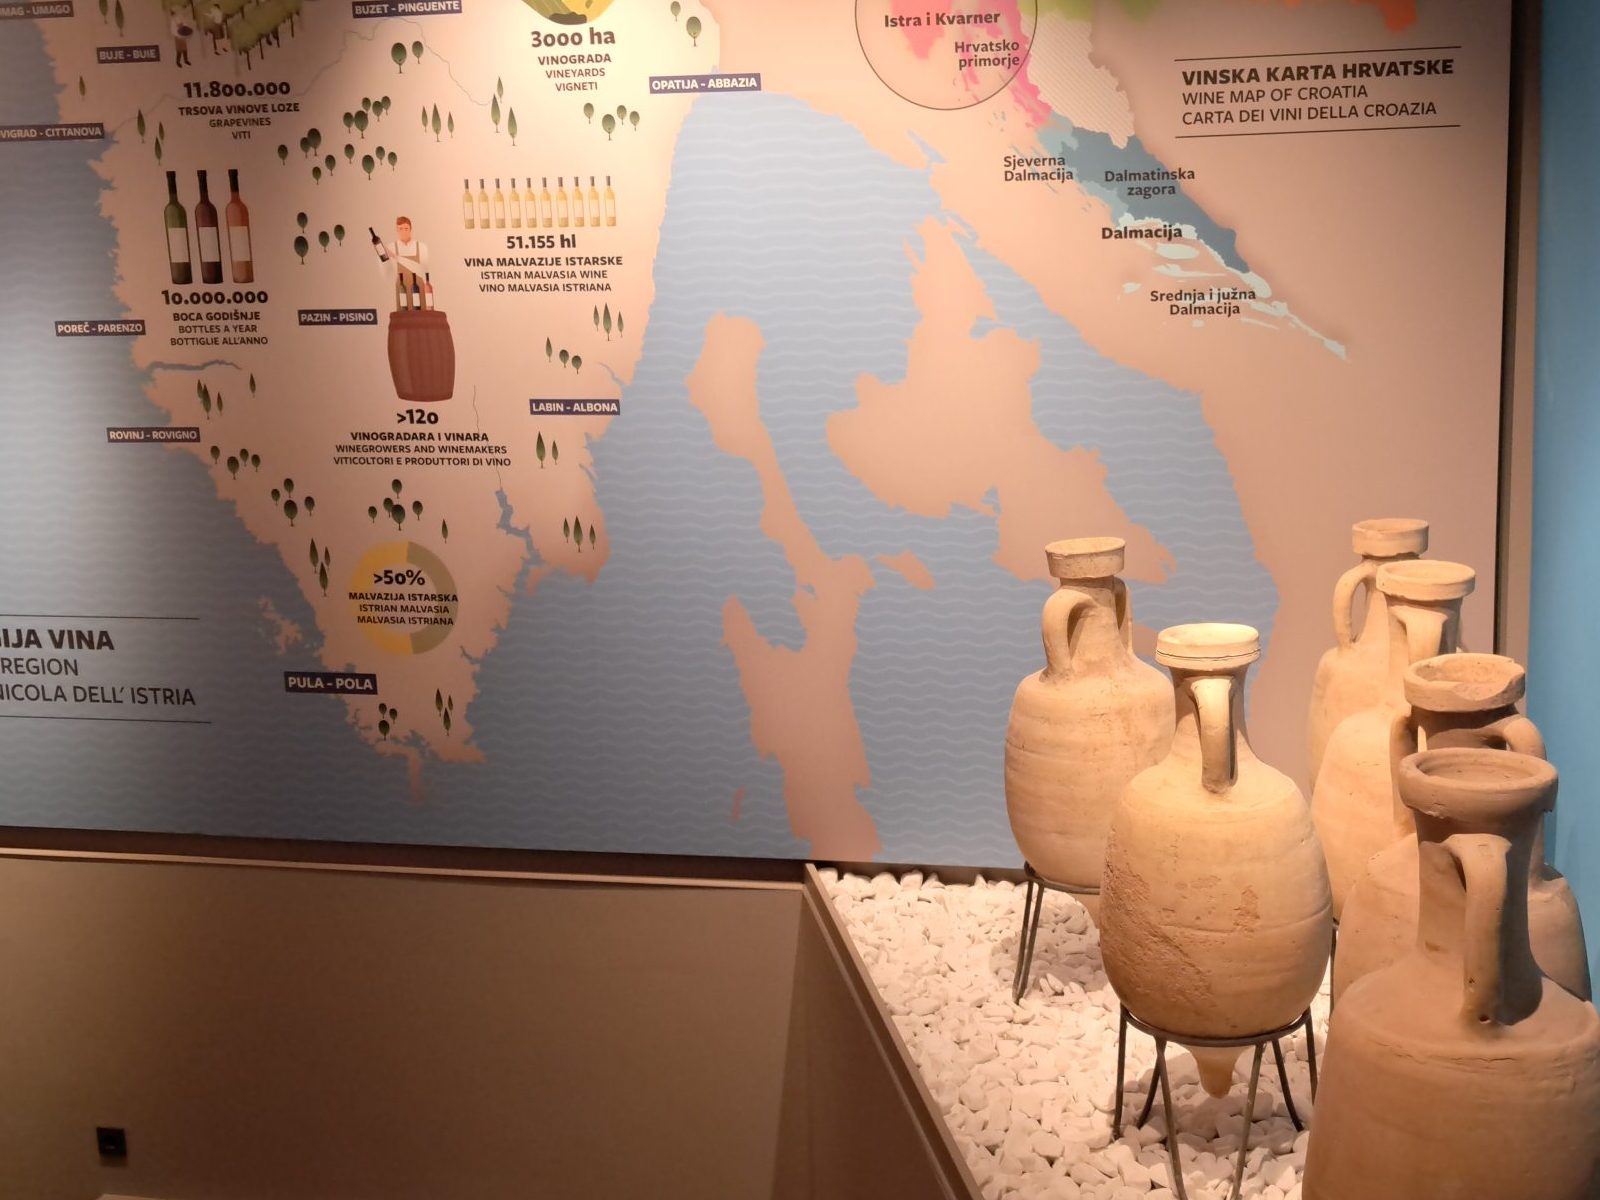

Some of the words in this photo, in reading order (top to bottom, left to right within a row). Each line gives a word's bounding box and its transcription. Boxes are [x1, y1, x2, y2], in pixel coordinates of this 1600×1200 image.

[355, 4, 388, 14] BUZET
[398, 1, 460, 12] PINGUENTE
[884, 14, 922, 27] Istra
[935, 12, 1000, 25] Kvarner
[531, 31, 583, 48] 3000
[589, 27, 616, 45] ha
[954, 39, 1020, 53] Hrvatsko
[538, 53, 612, 65] VINOGRADA
[959, 54, 1020, 70] primorje
[545, 68, 606, 79] VINEYARDS
[1182, 67, 1260, 86] VINSKA
[1266, 64, 1336, 82] KARTA
[1342, 59, 1455, 79] HRVATSKE
[183, 81, 291, 98] 11.800.000
[555, 82, 598, 91] VIGNETI
[652, 79, 699, 90] OPATIJA
[707, 77, 757, 88] ABBAZIA
[1182, 91, 1225, 105] WINE
[1230, 90, 1265, 103] MAP
[1270, 88, 1293, 102] OF
[1297, 85, 1368, 100] CROATIA
[178, 105, 223, 116] TRSOVA
[225, 104, 268, 114] VINOVE
[271, 102, 300, 112] LOZE
[1182, 111, 1234, 125] CARTA
[1239, 109, 1265, 122] DEI
[1270, 108, 1301, 121] VINI
[1307, 104, 1359, 120] DELLA
[1364, 101, 1437, 118] CROAZIA
[209, 117, 271, 127] GRAPEVINES
[45, 127, 102, 137] CITTANOVA
[232, 131, 251, 139] VITI
[1003, 155, 1066, 170] Sjeverna
[1004, 168, 1074, 183] Dalmacija
[1104, 168, 1195, 182] Dalmatinska
[1127, 185, 1176, 199] zagora
[1101, 225, 1183, 241] Dalmacija
[506, 235, 555, 249] 51.155
[560, 234, 576, 248] hl
[464, 258, 494, 267] VINA
[496, 257, 562, 267] MALVAZIJE
[566, 256, 623, 266] ISTARSKE
[481, 271, 522, 280] ISTRIAN
[525, 270, 577, 279] MALVASIA
[580, 270, 608, 279] WINE
[479, 284, 505, 292] VINO
[508, 283, 559, 292] MALVASIA
[563, 283, 612, 292] ISTRIANA
[161, 290, 268, 305] 10.000.000
[1150, 289, 1205, 304] Srednja
[1217, 288, 1256, 304] južna
[173, 312, 203, 321] BOCA
[206, 309, 261, 321] GODIŠNJE
[1170, 303, 1240, 317] Dalmacija
[301, 313, 331, 322] PAZIN
[339, 313, 374, 322] PISINO
[58, 321, 89, 333] POREČ
[98, 323, 142, 333] PARENZO
[178, 325, 221, 334] BOTTLES
[232, 325, 257, 333] YEAR
[170, 337, 219, 346] BOTTIGLIE
[532, 403, 564, 412] LABIN
[573, 403, 618, 412] ALBONA
[109, 431, 144, 440] ROVINJ
[152, 431, 197, 439] ROVIGNO
[350, 432, 434, 441] VINOGRADARA
[445, 433, 489, 442] VINARA
[335, 445, 411, 453] WINEGROWERS
[414, 445, 435, 453] AND
[438, 445, 507, 454] WINEMAKERS
[333, 457, 394, 465] VITICOLTORI
[397, 457, 402, 465] E
[405, 457, 469, 466] PRODUTTORI
[473, 458, 482, 466] DI
[486, 458, 511, 466] VINO
[373, 569, 426, 585] >50%
[348, 592, 405, 601] MALVAZIJA
[408, 593, 459, 602] ISTARSKA
[359, 604, 398, 612] ISTRIAN
[400, 605, 450, 614] MALVASIA
[357, 616, 406, 624] MALVASIA
[408, 617, 454, 626] ISTRIANA
[0, 628, 42, 648] IJA
[48, 629, 115, 650] VINA
[1, 657, 79, 676] REGION
[288, 676, 325, 689] PULA
[335, 677, 373, 690] POLA
[131, 687, 196, 705] ISTRIA
